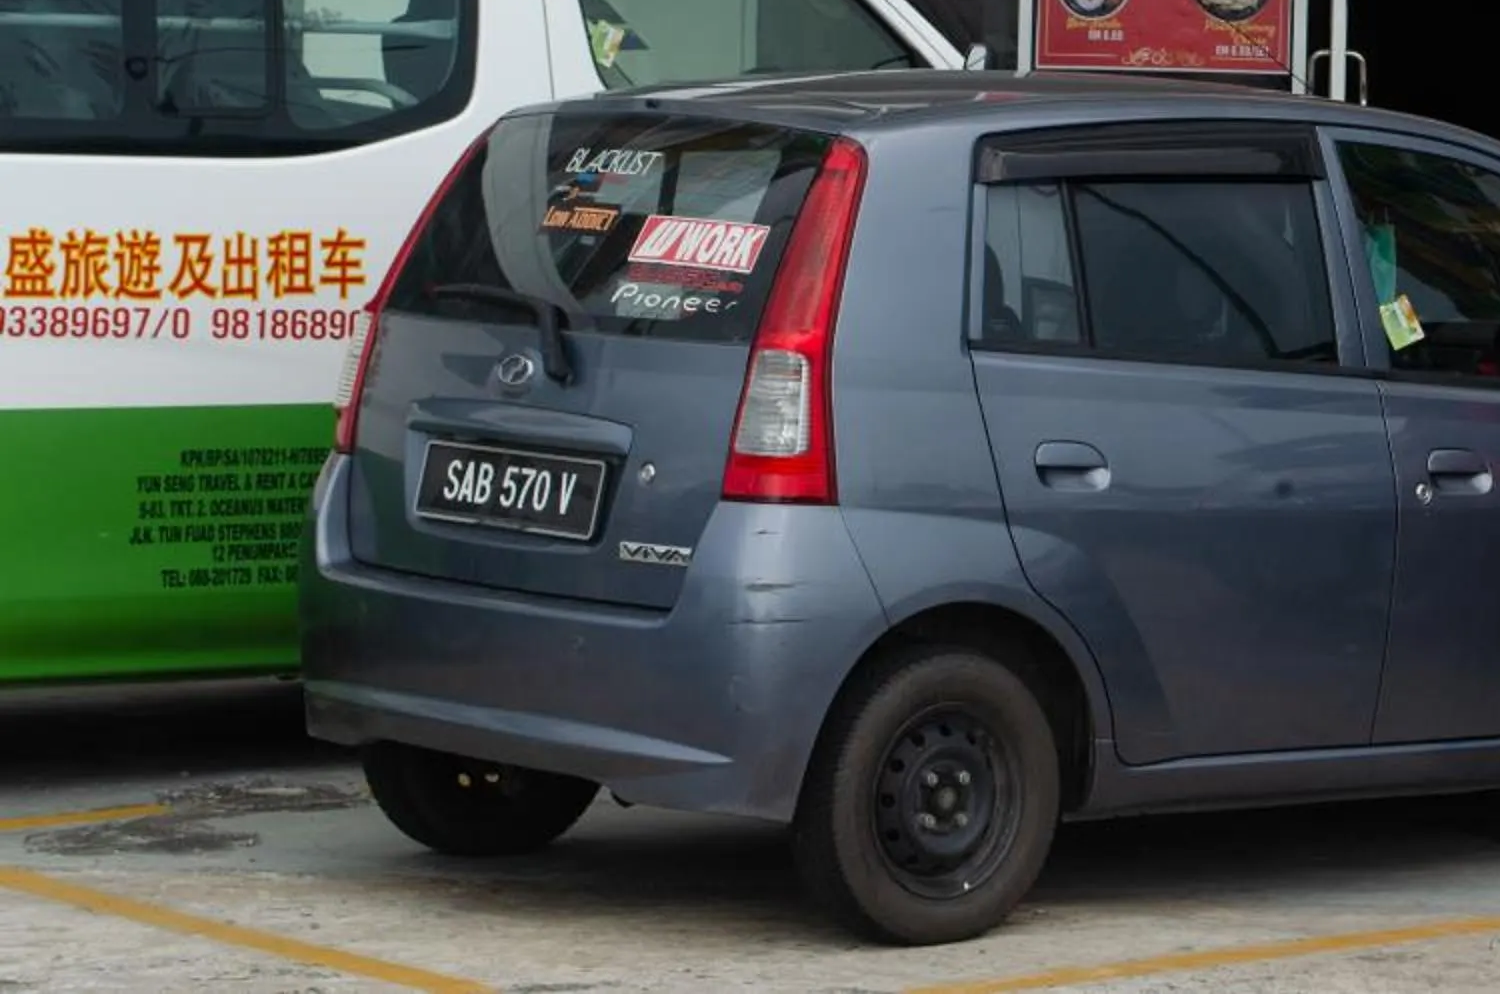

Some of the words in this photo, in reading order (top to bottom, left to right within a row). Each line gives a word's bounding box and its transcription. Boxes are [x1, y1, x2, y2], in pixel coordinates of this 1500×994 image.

[565, 148, 666, 176] BLACKLIST
[674, 223, 766, 269] WORK
[610, 283, 738, 313] Pioneer
[198, 473, 241, 492] TRAVEL
[255, 472, 285, 490] RENT
[442, 459, 491, 505] SAB
[499, 465, 552, 511] 570
[558, 472, 577, 516] V
